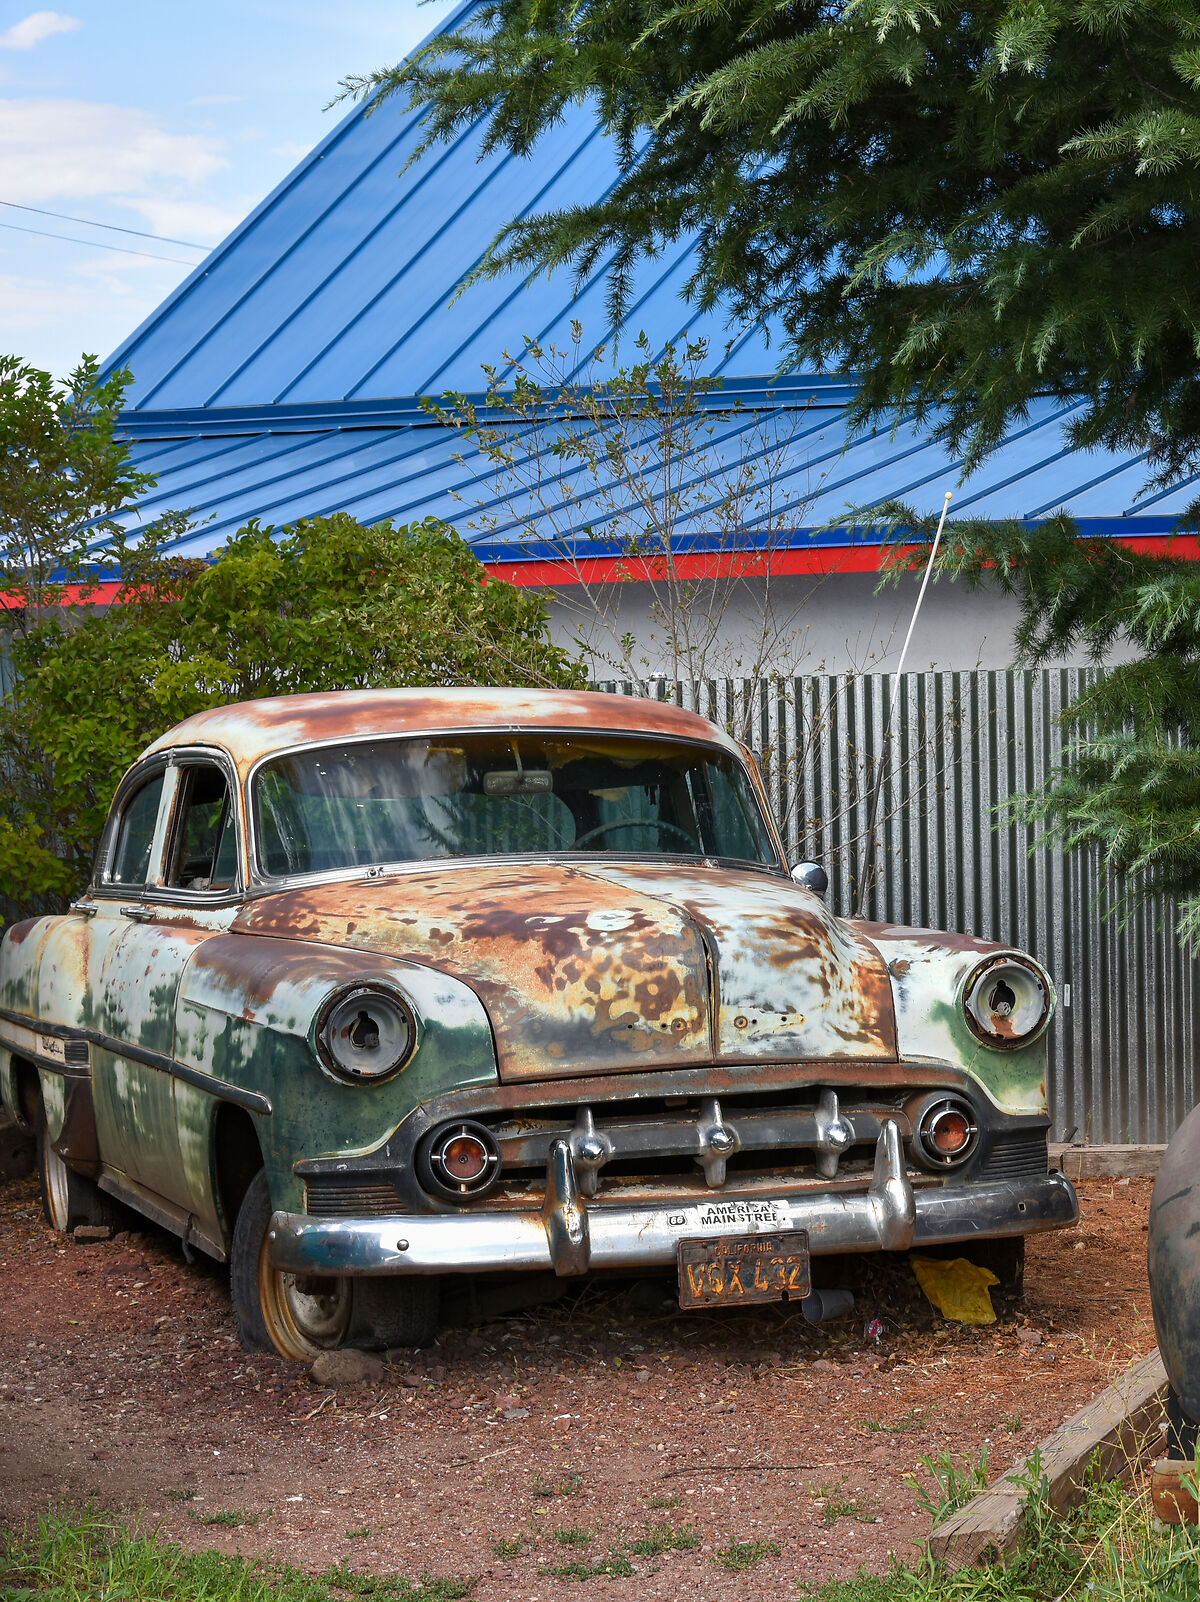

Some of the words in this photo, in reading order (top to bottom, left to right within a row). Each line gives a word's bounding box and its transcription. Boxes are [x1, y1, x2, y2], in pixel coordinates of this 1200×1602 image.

[701, 1213, 736, 1225] MAIN
[737, 1212, 783, 1223] STREE
[714, 1241, 773, 1257] CALIFORNIA
[754, 1255, 802, 1292] 432
